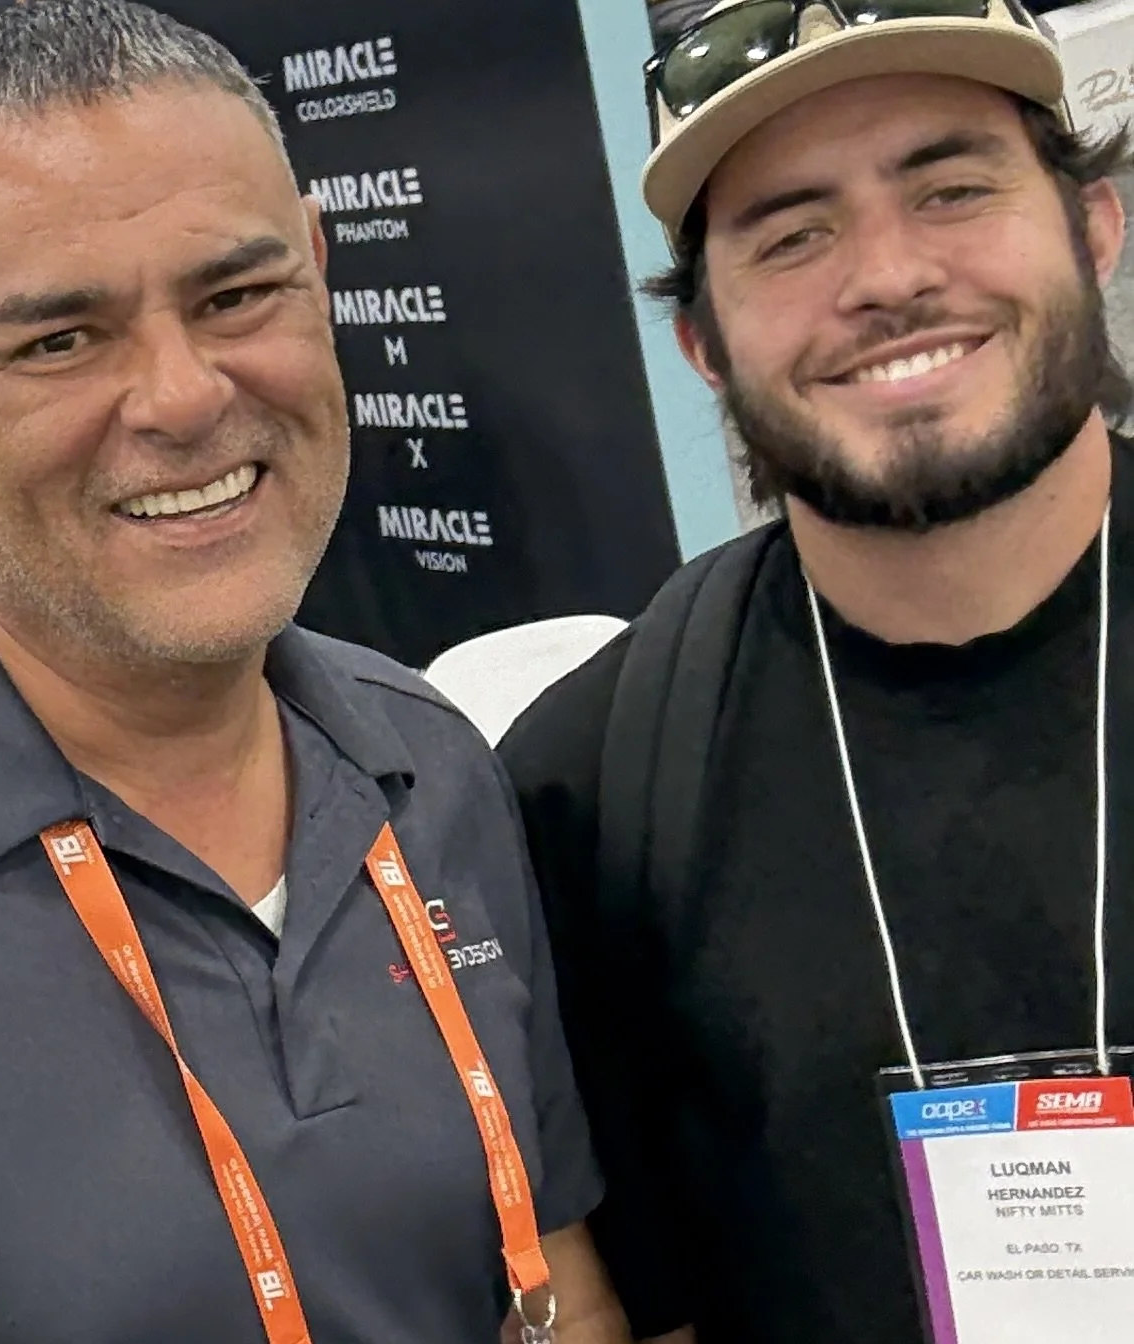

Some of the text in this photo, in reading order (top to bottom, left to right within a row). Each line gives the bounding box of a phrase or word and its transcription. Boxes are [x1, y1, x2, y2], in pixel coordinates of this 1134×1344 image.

[282, 36, 398, 93] MIRACLE
[296, 88, 397, 122] COLORSHIELD
[310, 167, 424, 213] MIRACLE
[335, 219, 410, 244] PHANTOM
[333, 285, 446, 325] MIRACLE
[384, 336, 409, 366] M
[355, 393, 469, 431] MIRACLE
[406, 437, 428, 469] X
[378, 505, 494, 548] MIRACLE
[415, 551, 468, 574] VISION
[1036, 1092, 1103, 1110] SEMA
[990, 1160, 1072, 1177] LUQMAN
[987, 1186, 1085, 1201] HERNANDEZ
[996, 1204, 1084, 1217] NIFTY MITTS
[957, 1270, 983, 1281] CAR
[986, 1269, 1023, 1280] WASH
[1047, 1268, 1092, 1280] DETAIL
